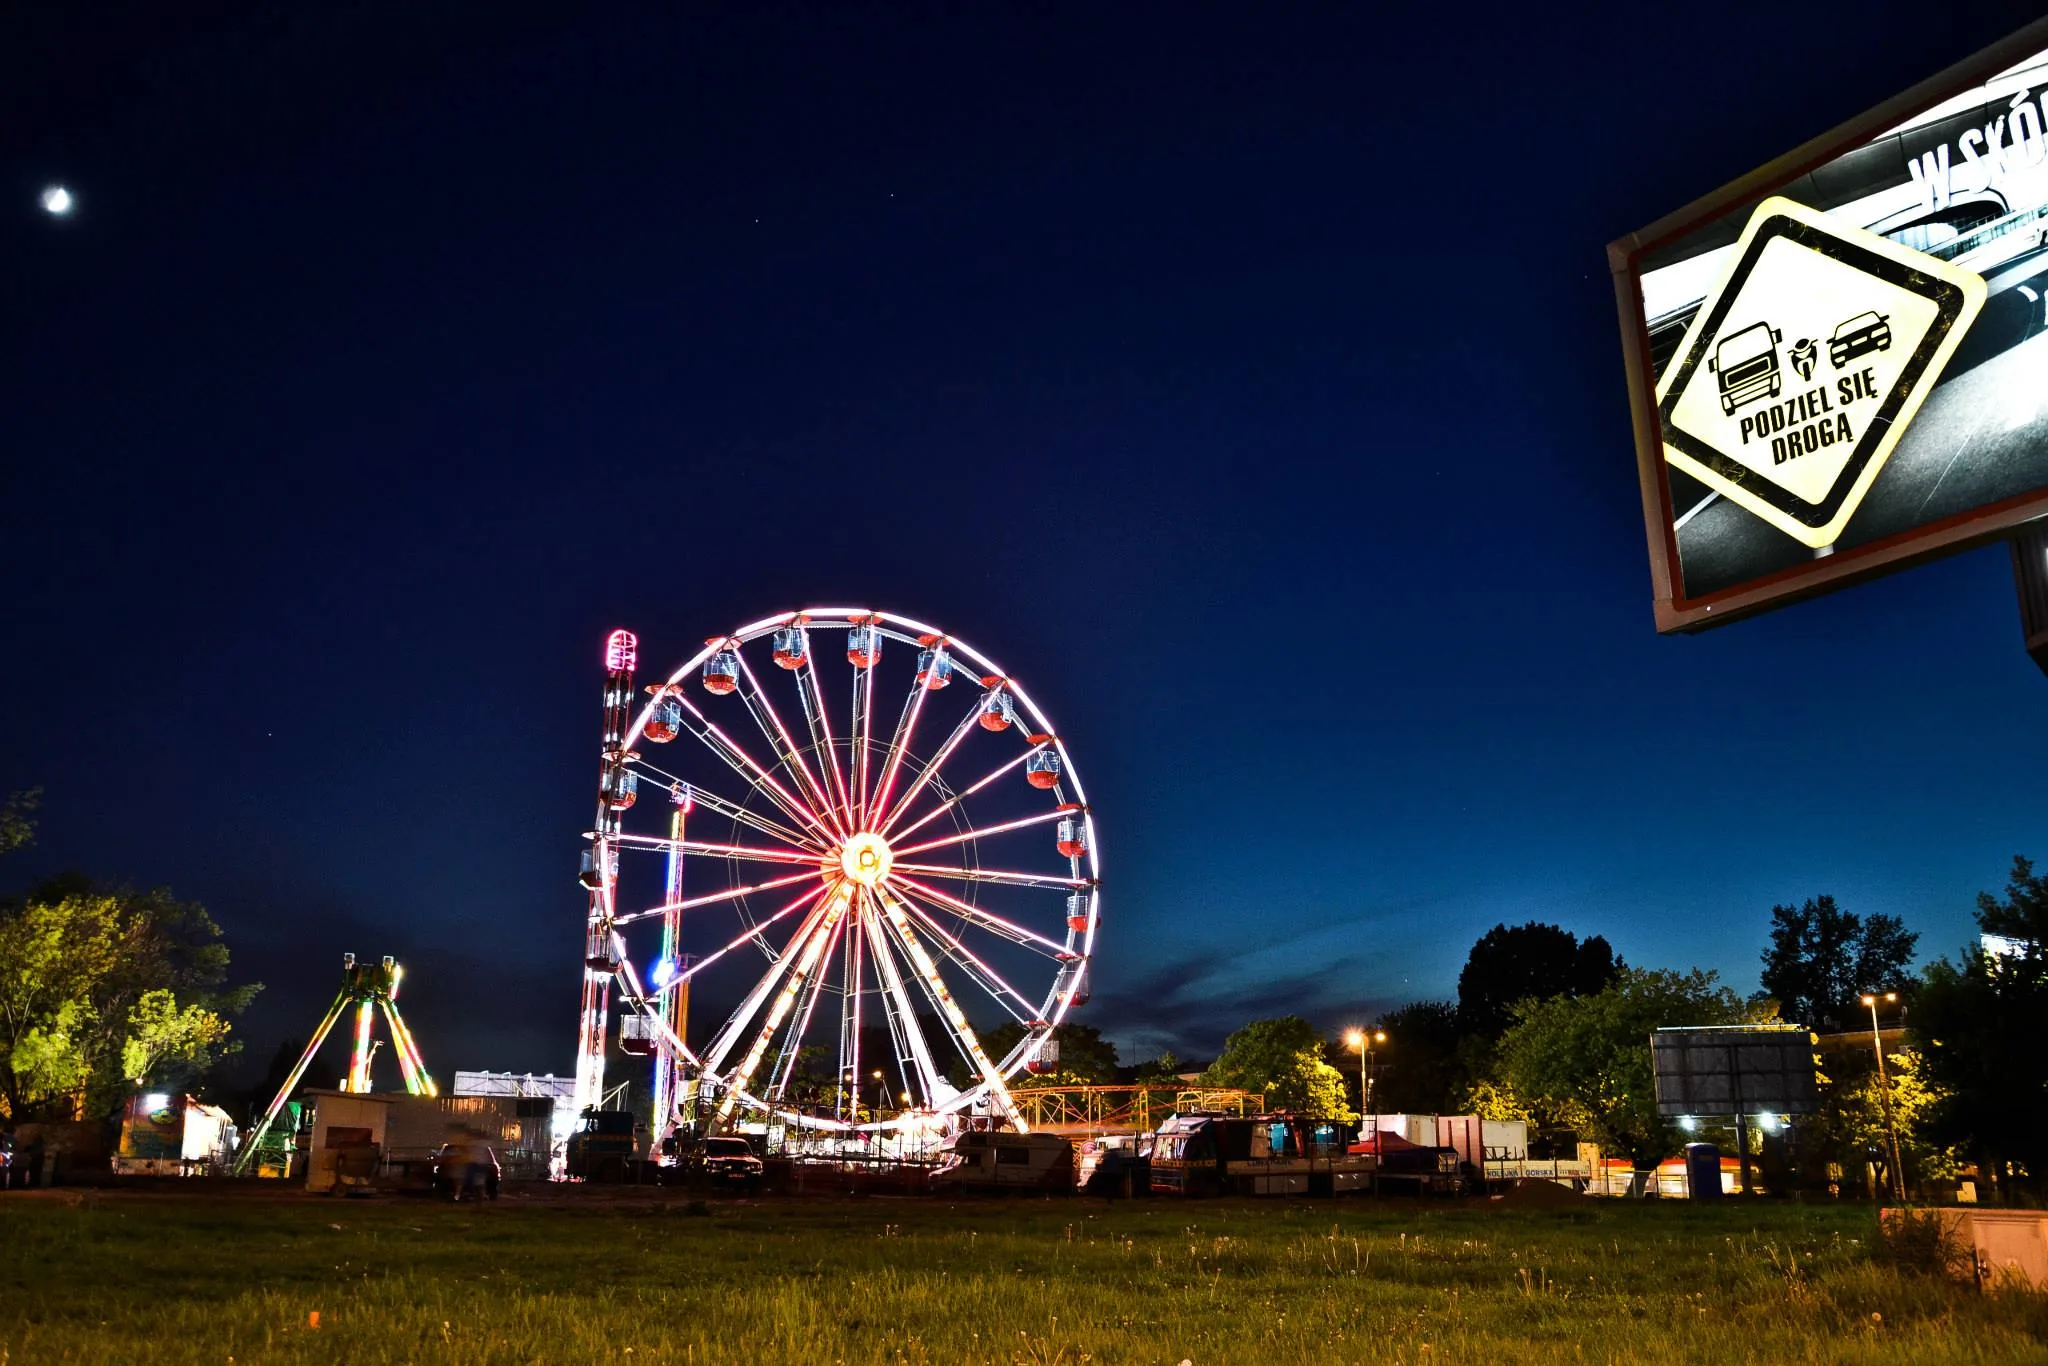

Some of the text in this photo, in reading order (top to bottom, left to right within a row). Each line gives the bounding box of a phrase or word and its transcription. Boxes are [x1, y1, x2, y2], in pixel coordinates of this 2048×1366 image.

[1908, 143, 1951, 212] W
[1740, 366, 1878, 445] PODZIEL SIĘ
[1771, 412, 1854, 466] DROGĄ
[1487, 1169, 1519, 1177] KOLJKA
